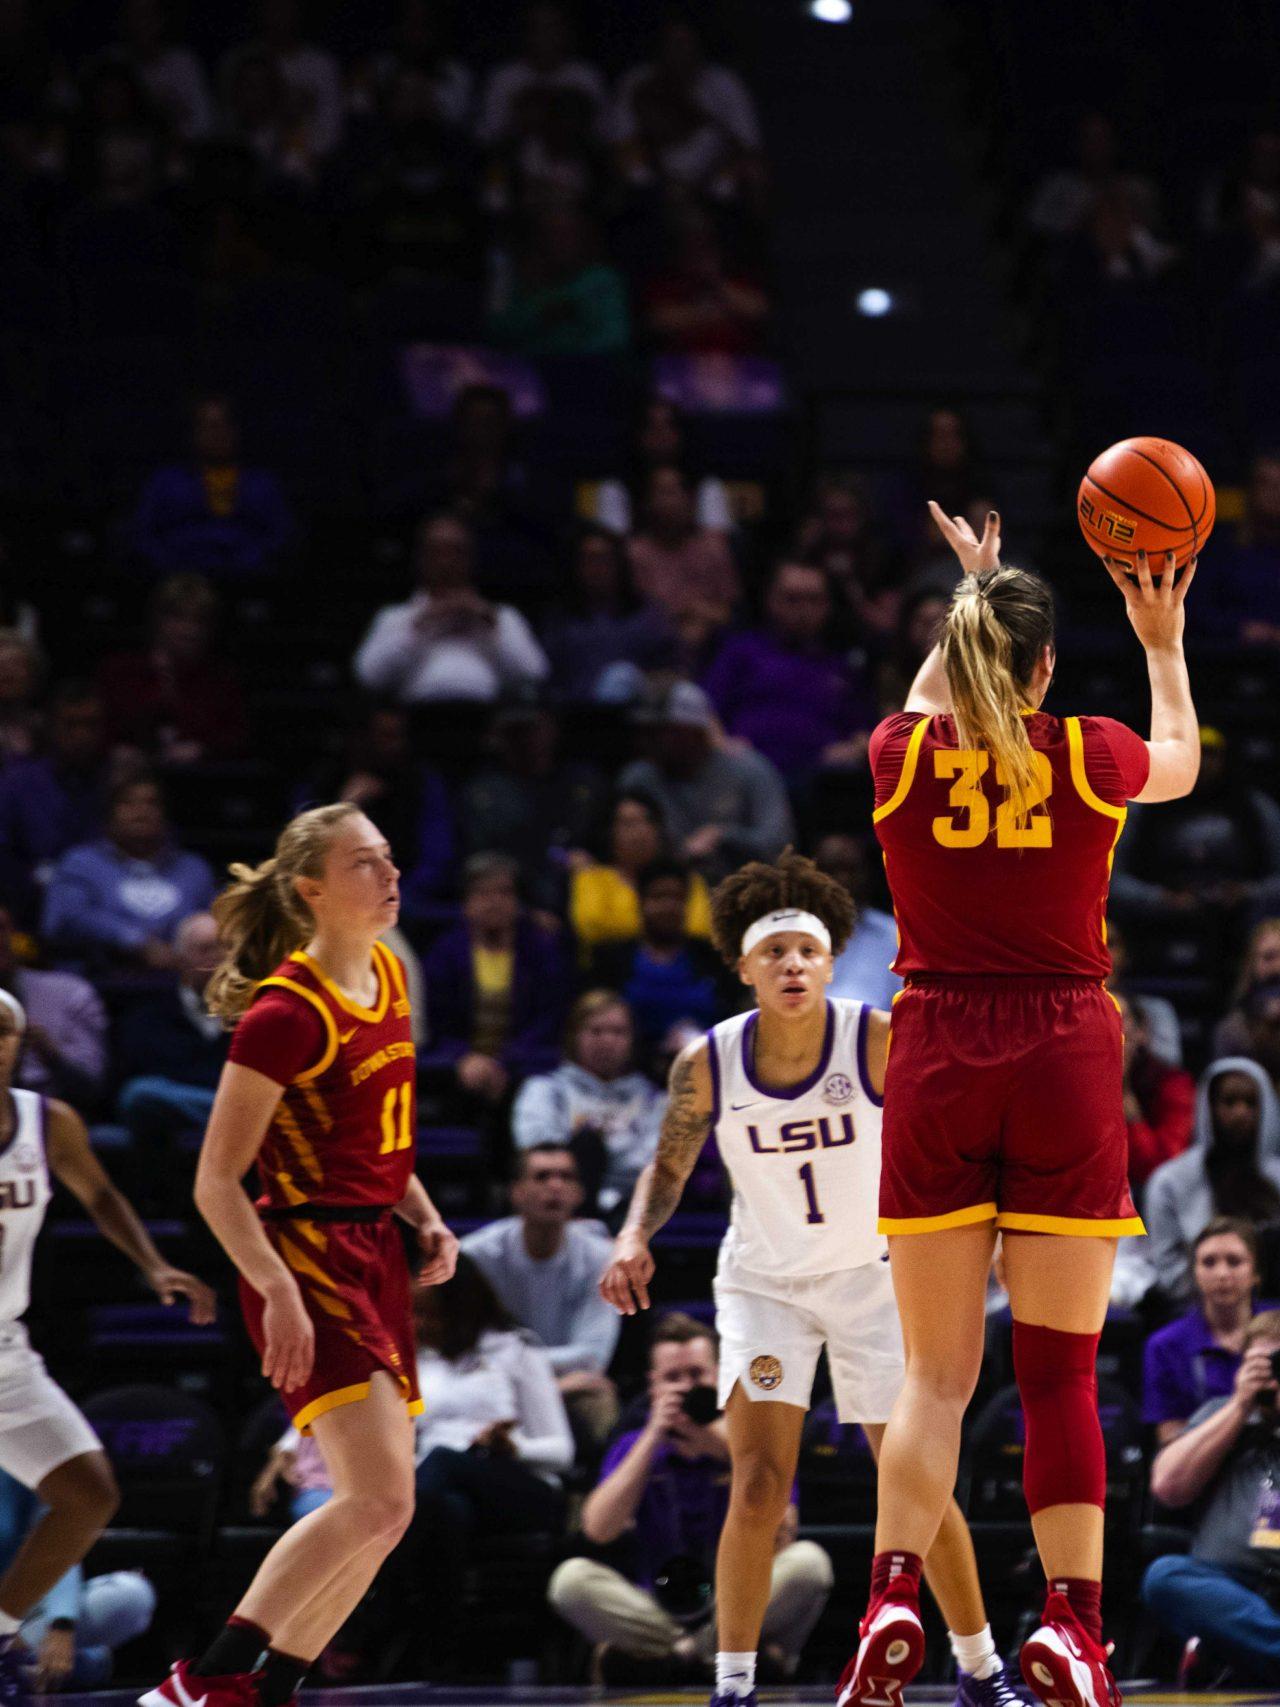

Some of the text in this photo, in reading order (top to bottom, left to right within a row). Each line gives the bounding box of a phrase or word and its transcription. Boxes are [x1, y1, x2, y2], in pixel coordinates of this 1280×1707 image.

[1080, 496, 1135, 544] ELITE
[932, 750, 1053, 848] 32
[378, 1080, 413, 1156] 11
[747, 1113, 856, 1153] LSU
[799, 1162, 825, 1224] 1
